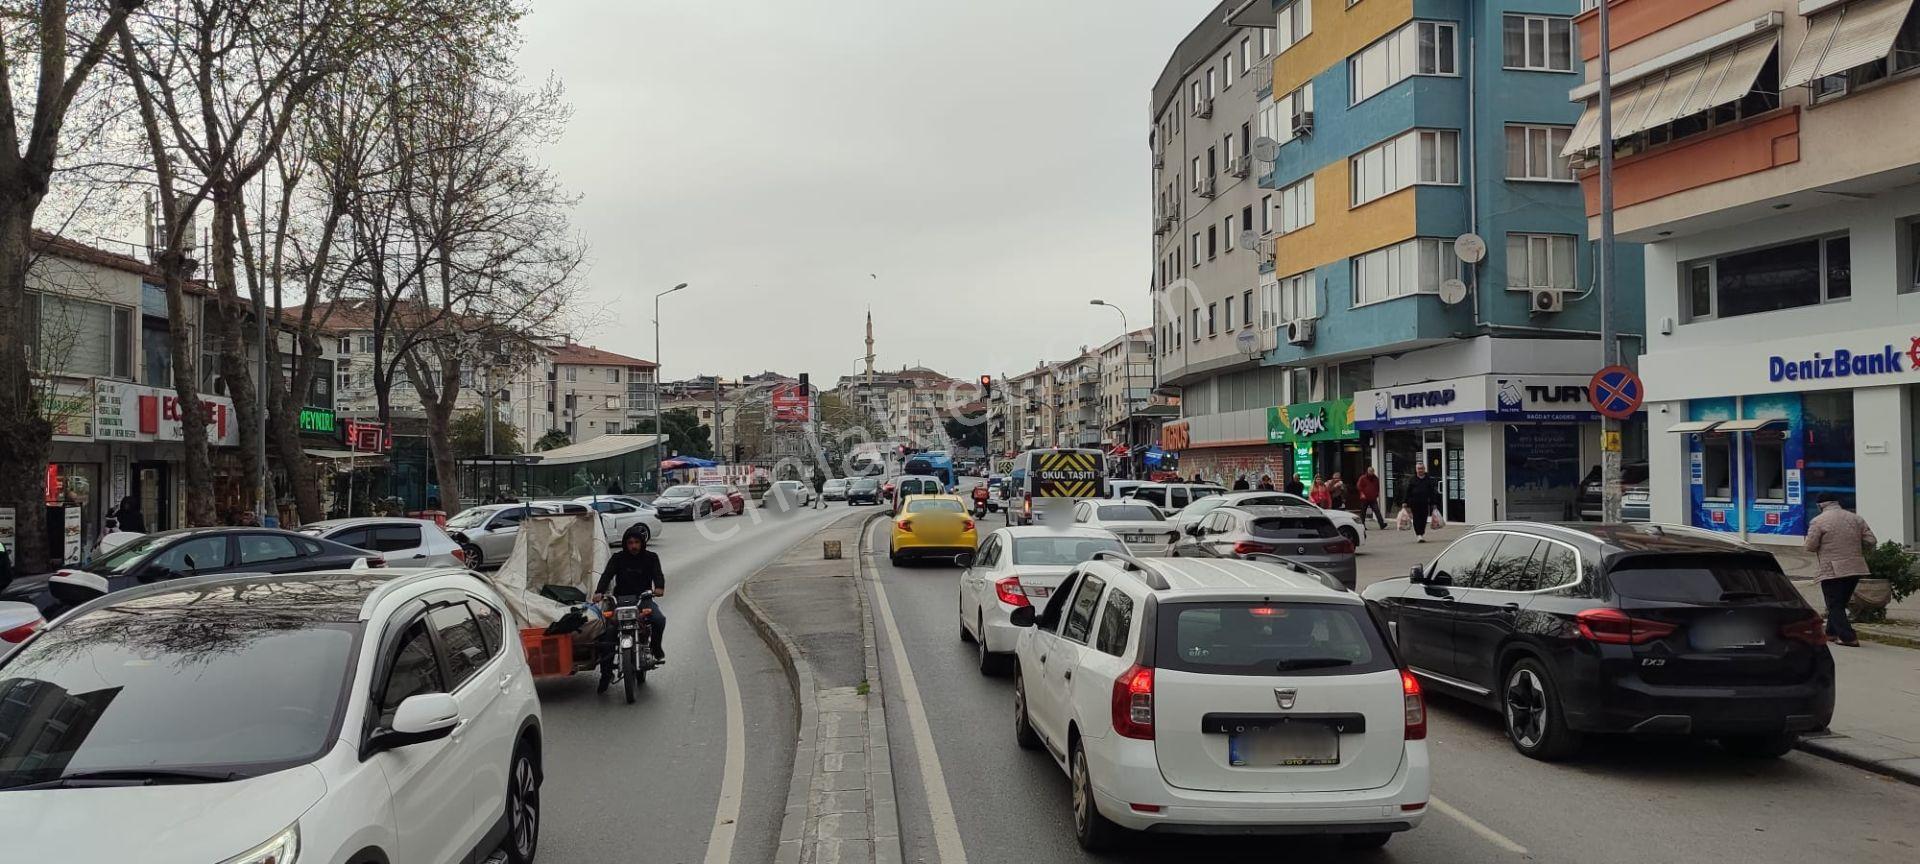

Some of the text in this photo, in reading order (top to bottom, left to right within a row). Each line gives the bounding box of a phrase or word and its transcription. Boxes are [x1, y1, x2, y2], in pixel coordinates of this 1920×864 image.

[1769, 345, 1903, 382] DenizBank
[1391, 389, 1456, 409] TURYAP
[1525, 385, 1591, 403] TURY
[1042, 470, 1095, 481] OKUL TAŞITI
